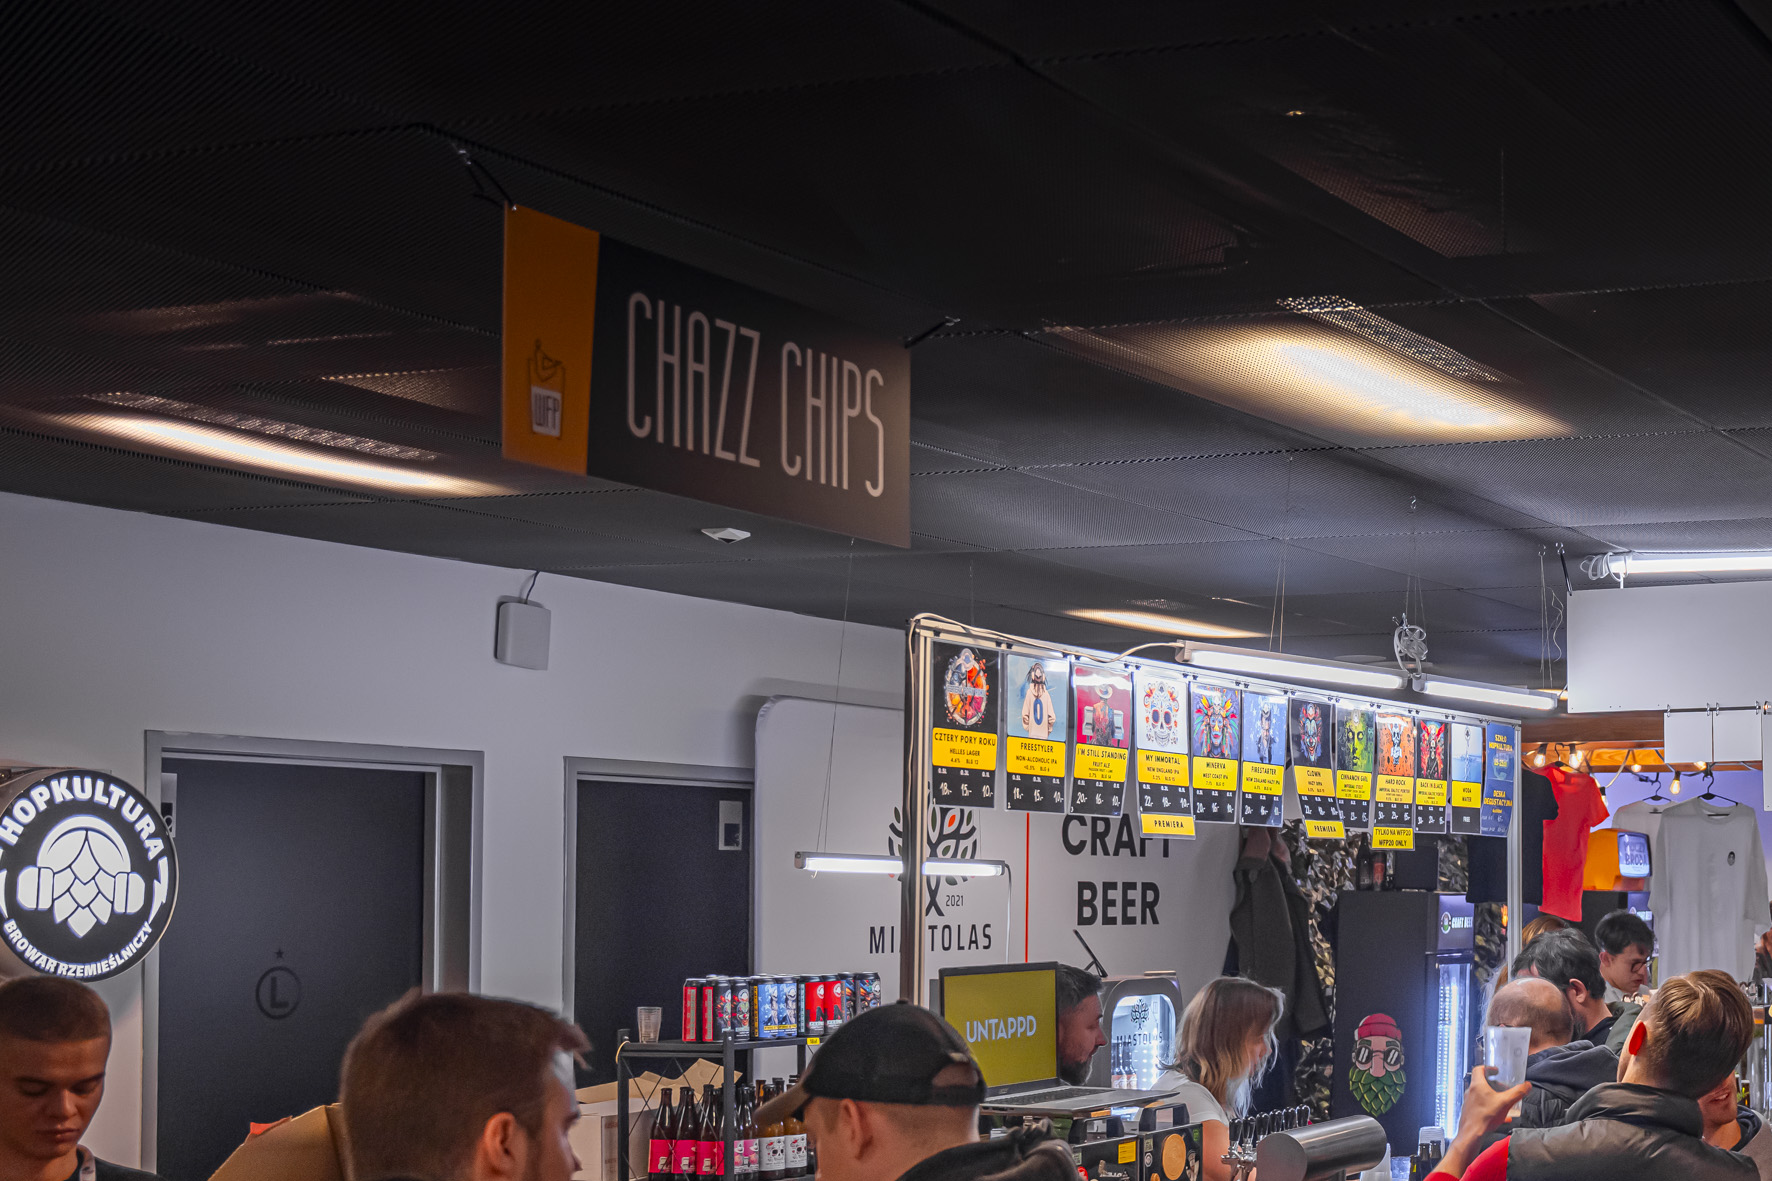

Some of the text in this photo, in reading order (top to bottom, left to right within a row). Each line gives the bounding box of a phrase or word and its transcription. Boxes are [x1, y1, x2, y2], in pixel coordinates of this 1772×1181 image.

[627, 291, 885, 498] CHAZZ CHIPS
[934, 732, 996, 747] CZTERY PORY ROKU
[1495, 734, 1507, 743] SZKŁO
[1020, 742, 1054, 753] FREESTYLER
[1489, 741, 1513, 752] HOPKULTURA
[949, 748, 981, 757] HELLES LAGER
[1077, 748, 1126, 761] I'M STILL STANDING
[1015, 755, 1050, 765] NON-ALCOHOLIC
[1145, 754, 1181, 765] MY IMMORTAL
[1206, 761, 1226, 769] MINERVA
[1251, 766, 1277, 775] FIRESTARTER
[1340, 773, 1360, 781] CINNAMON
[1493, 790, 1505, 798] DESKA
[1483, 798, 1513, 807] DEGUSTACYJNA
[0, 775, 165, 862] HOPKULTURA
[1154, 819, 1184, 829] PREMIERA
[1375, 828, 1389, 836] TYLKO
[945, 894, 964, 907] 2021
[1077, 881, 1160, 926] BEER
[869, 922, 993, 954] MITOLAS
[3, 918, 154, 979] BROWAR RZEMIEŚLNICZY
[966, 1015, 1037, 1043] UNTAPPD
[1116, 1031, 1163, 1046] MIASTOLS
